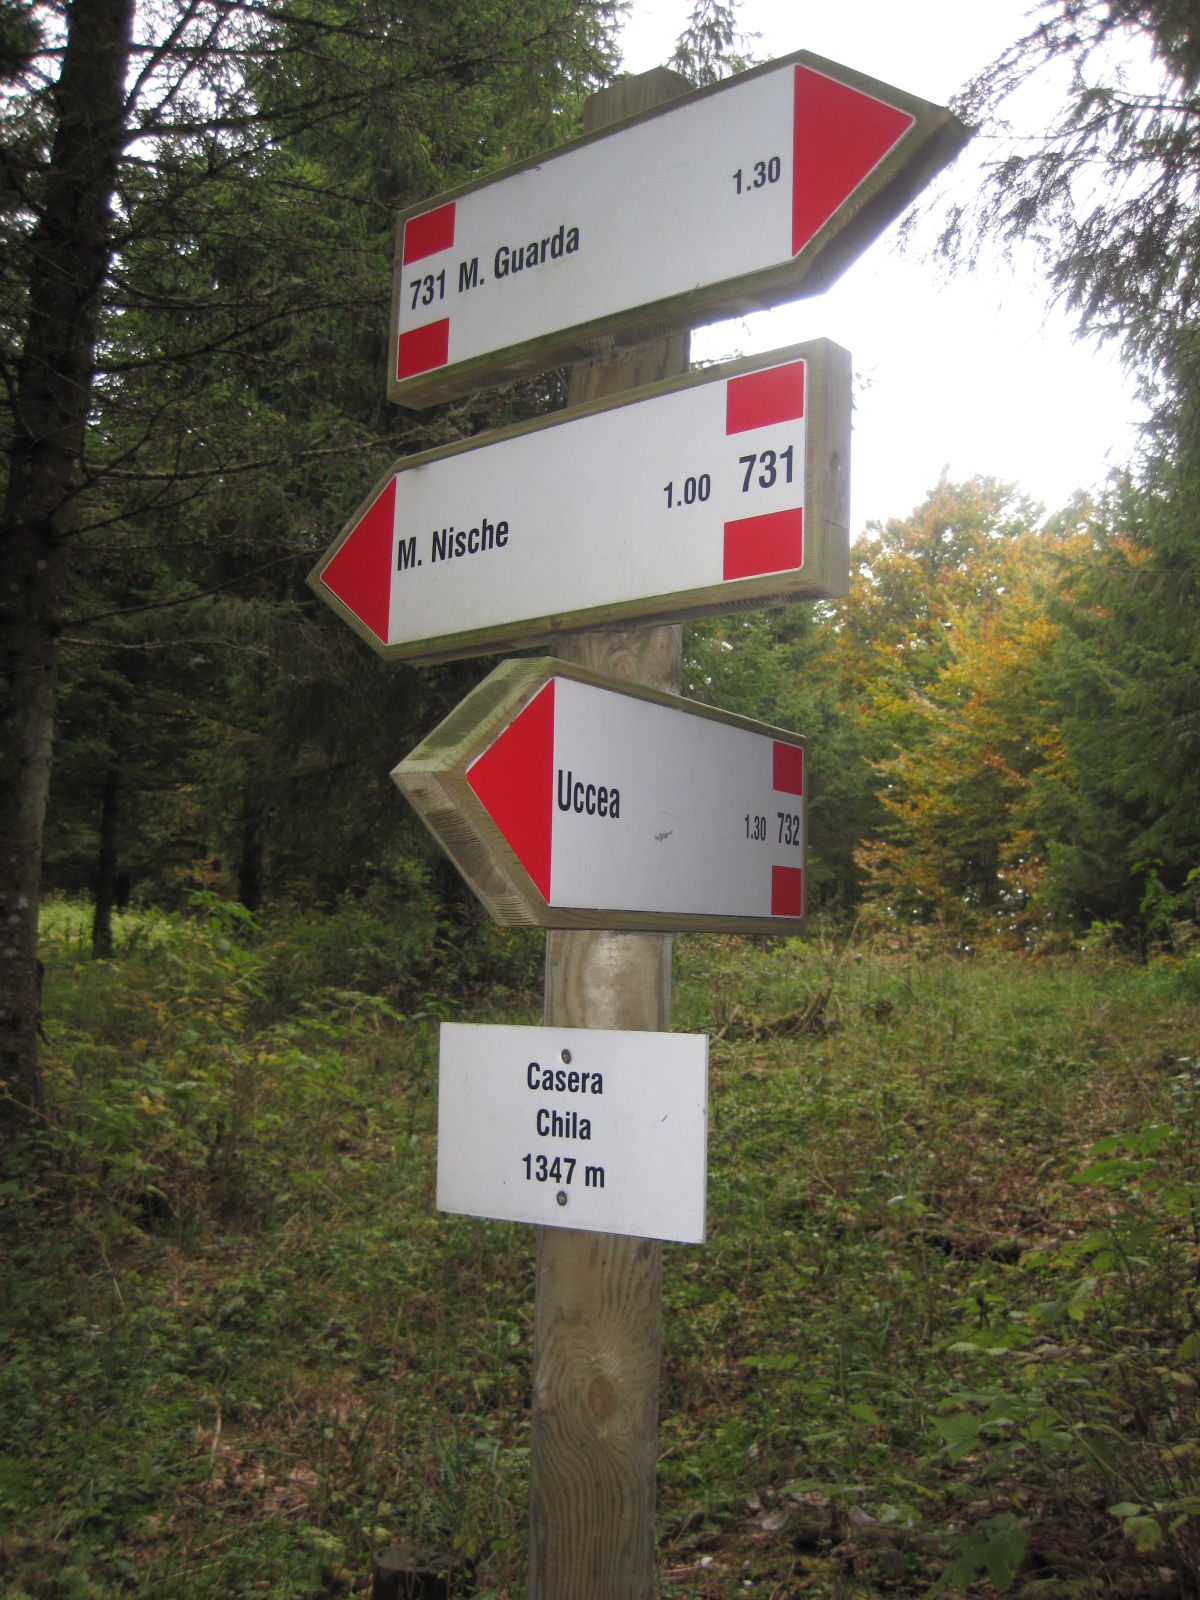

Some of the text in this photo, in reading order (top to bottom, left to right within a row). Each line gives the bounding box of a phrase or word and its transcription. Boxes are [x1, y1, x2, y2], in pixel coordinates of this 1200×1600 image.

[733, 157, 780, 194] 1.30
[410, 225, 579, 310] 731 M. Guarda
[664, 445, 793, 508] 1.00 731
[398, 519, 508, 571] M. Nische
[558, 770, 619, 818] Uccea
[745, 812, 799, 846] 1.30 732
[527, 1062, 602, 1094] Casera
[537, 1109, 590, 1140] Chila
[523, 1154, 604, 1188] 1347 m
